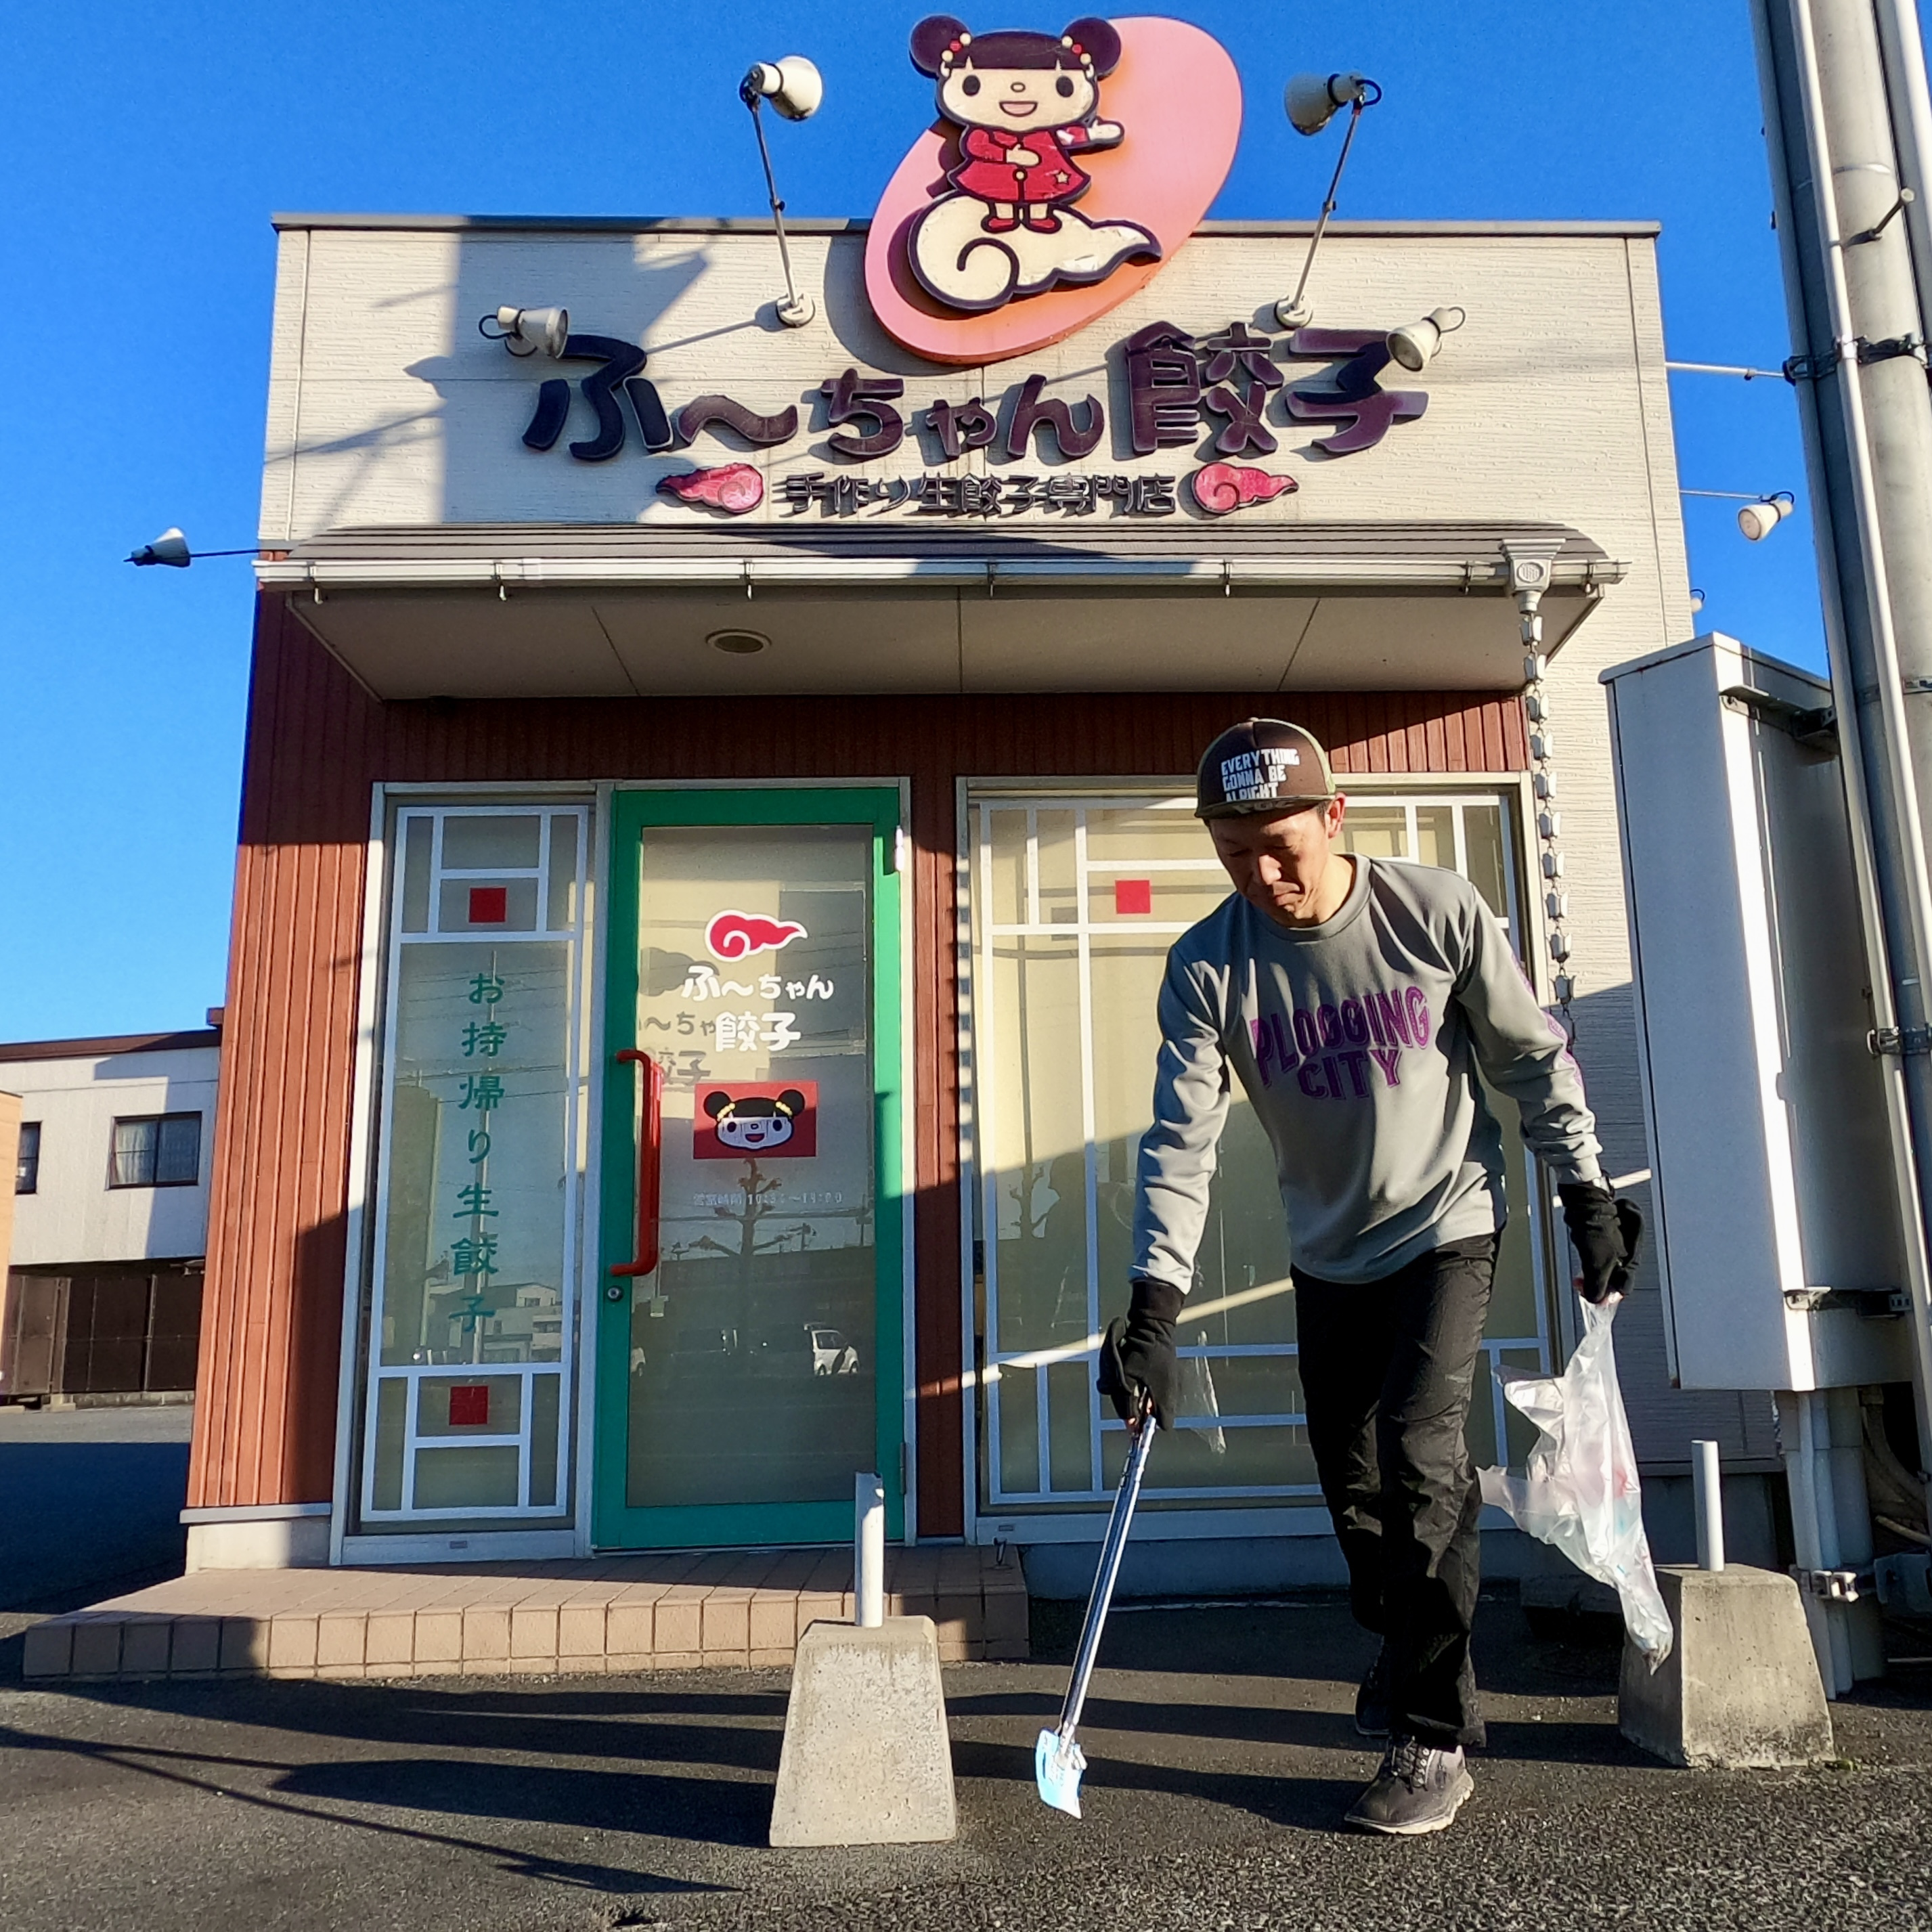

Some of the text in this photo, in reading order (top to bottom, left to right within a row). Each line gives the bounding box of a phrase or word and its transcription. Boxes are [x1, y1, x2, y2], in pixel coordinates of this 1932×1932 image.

[785, 472, 1177, 515] 手作り生餃子専門店
[1222, 764, 1287, 792] GONNA BE
[714, 1011, 802, 1053] 餃子
[1249, 985, 1431, 1089] PLOGGING
[1296, 1048, 1403, 1101] CITY
[448, 972, 508, 1333] お持帰り生餃子
